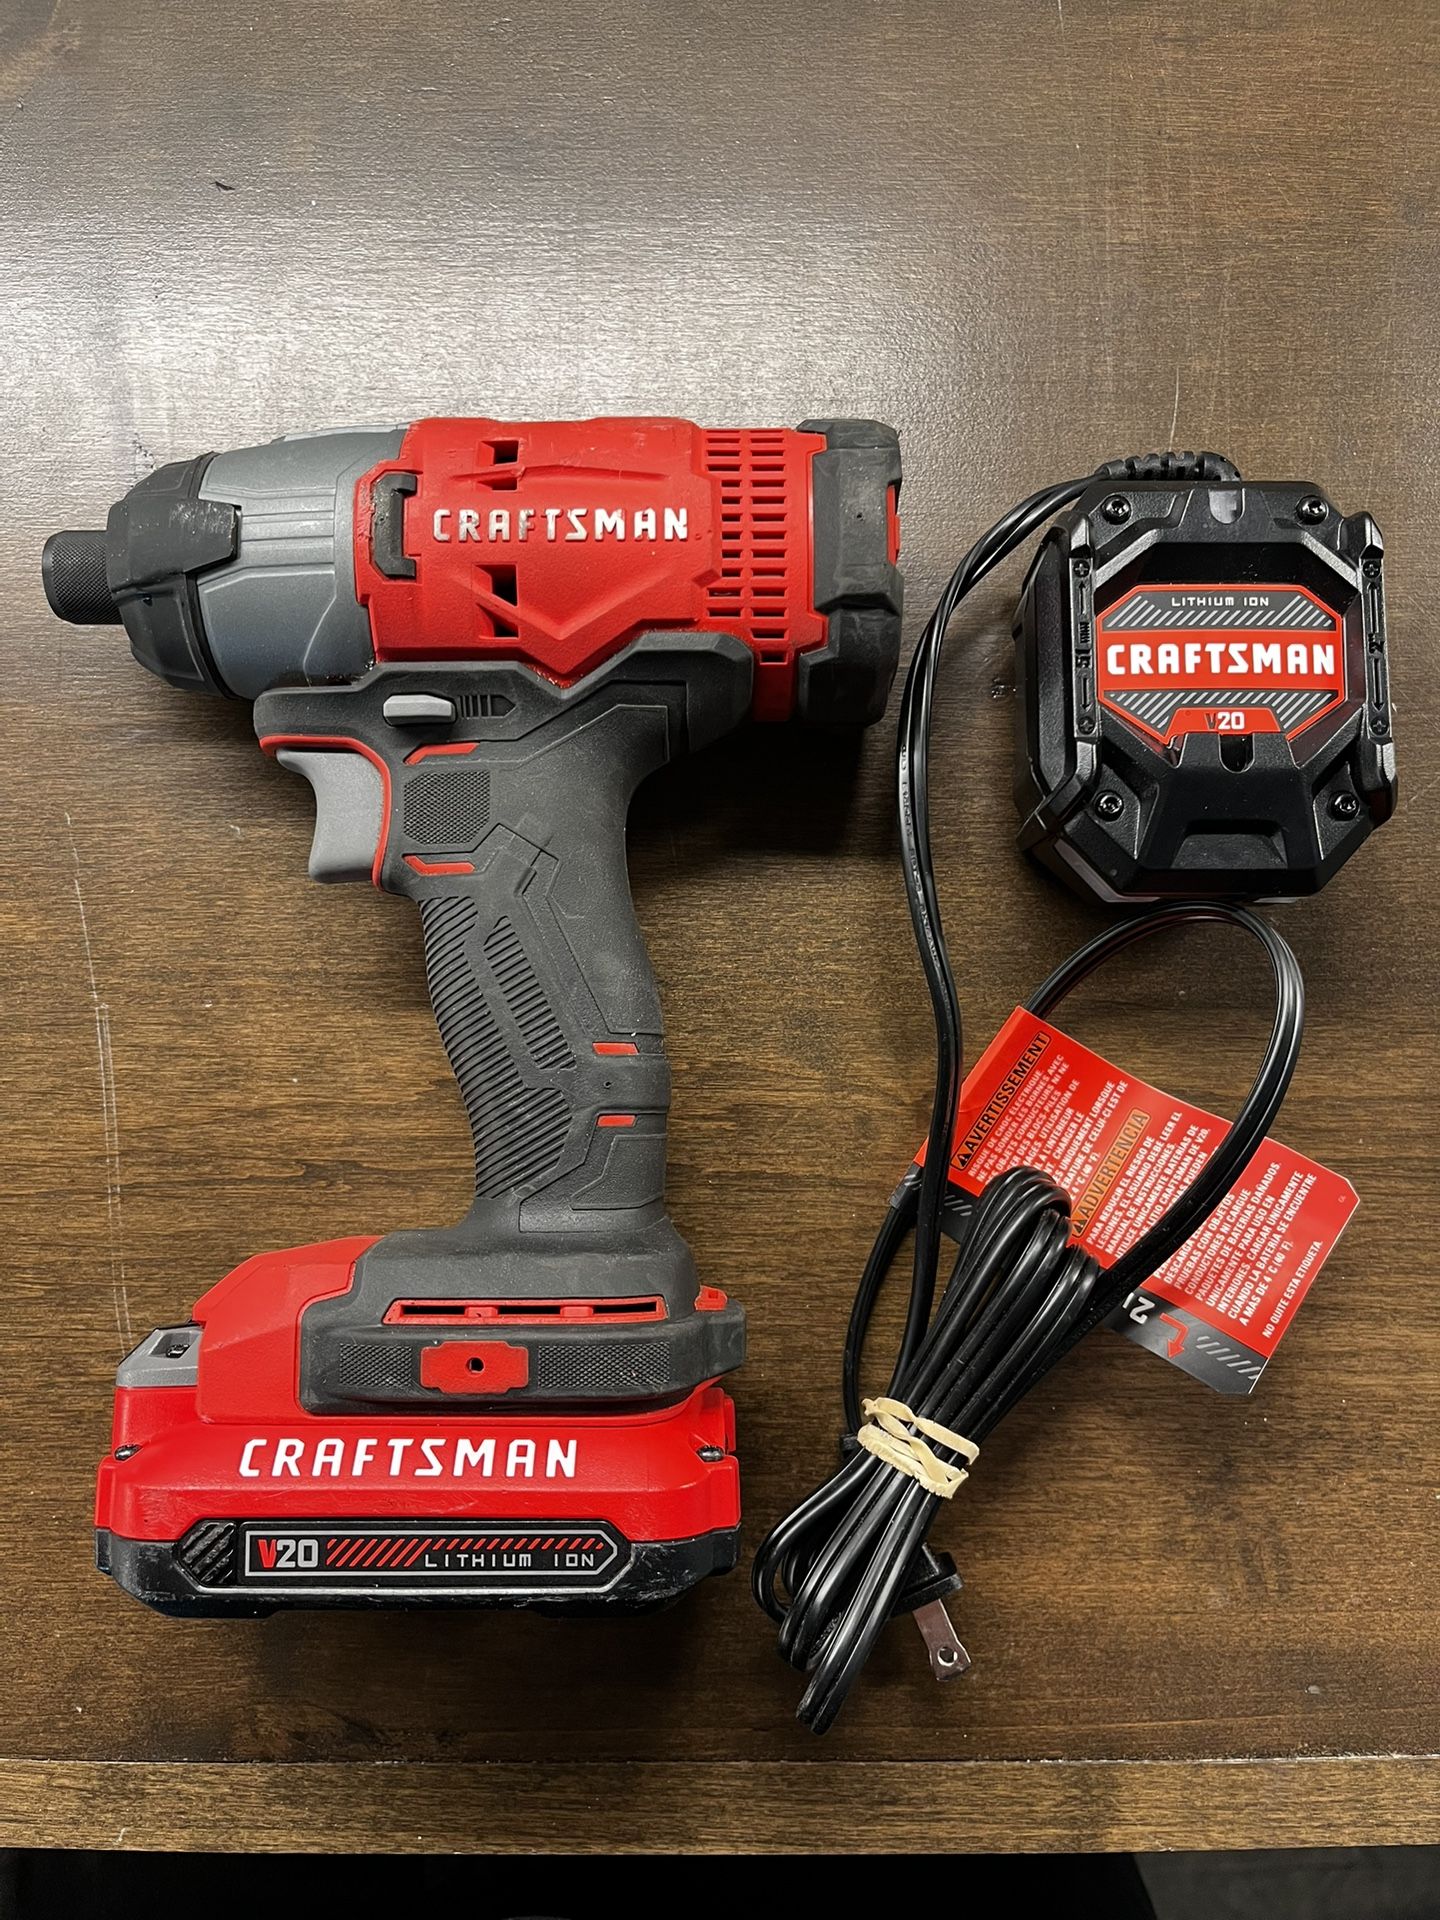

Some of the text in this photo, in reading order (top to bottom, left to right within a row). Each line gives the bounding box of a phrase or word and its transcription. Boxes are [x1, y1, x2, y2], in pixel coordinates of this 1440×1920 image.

[433, 507, 688, 542] CRAFTSMAN
[1171, 597, 1270, 607] LITHIUM ION
[1107, 643, 1335, 675] CRAFTSMAN
[1204, 712, 1245, 730] V20
[963, 1034, 1048, 1152] AVERTISSEMENT
[1076, 1110, 1148, 1218] ADVERTENCIA
[1158, 1153, 1193, 1205] CRAFTSMAN
[239, 1438, 577, 1478] CRAFTSMAN
[257, 1539, 594, 1568] V20 LITHIUM ION
